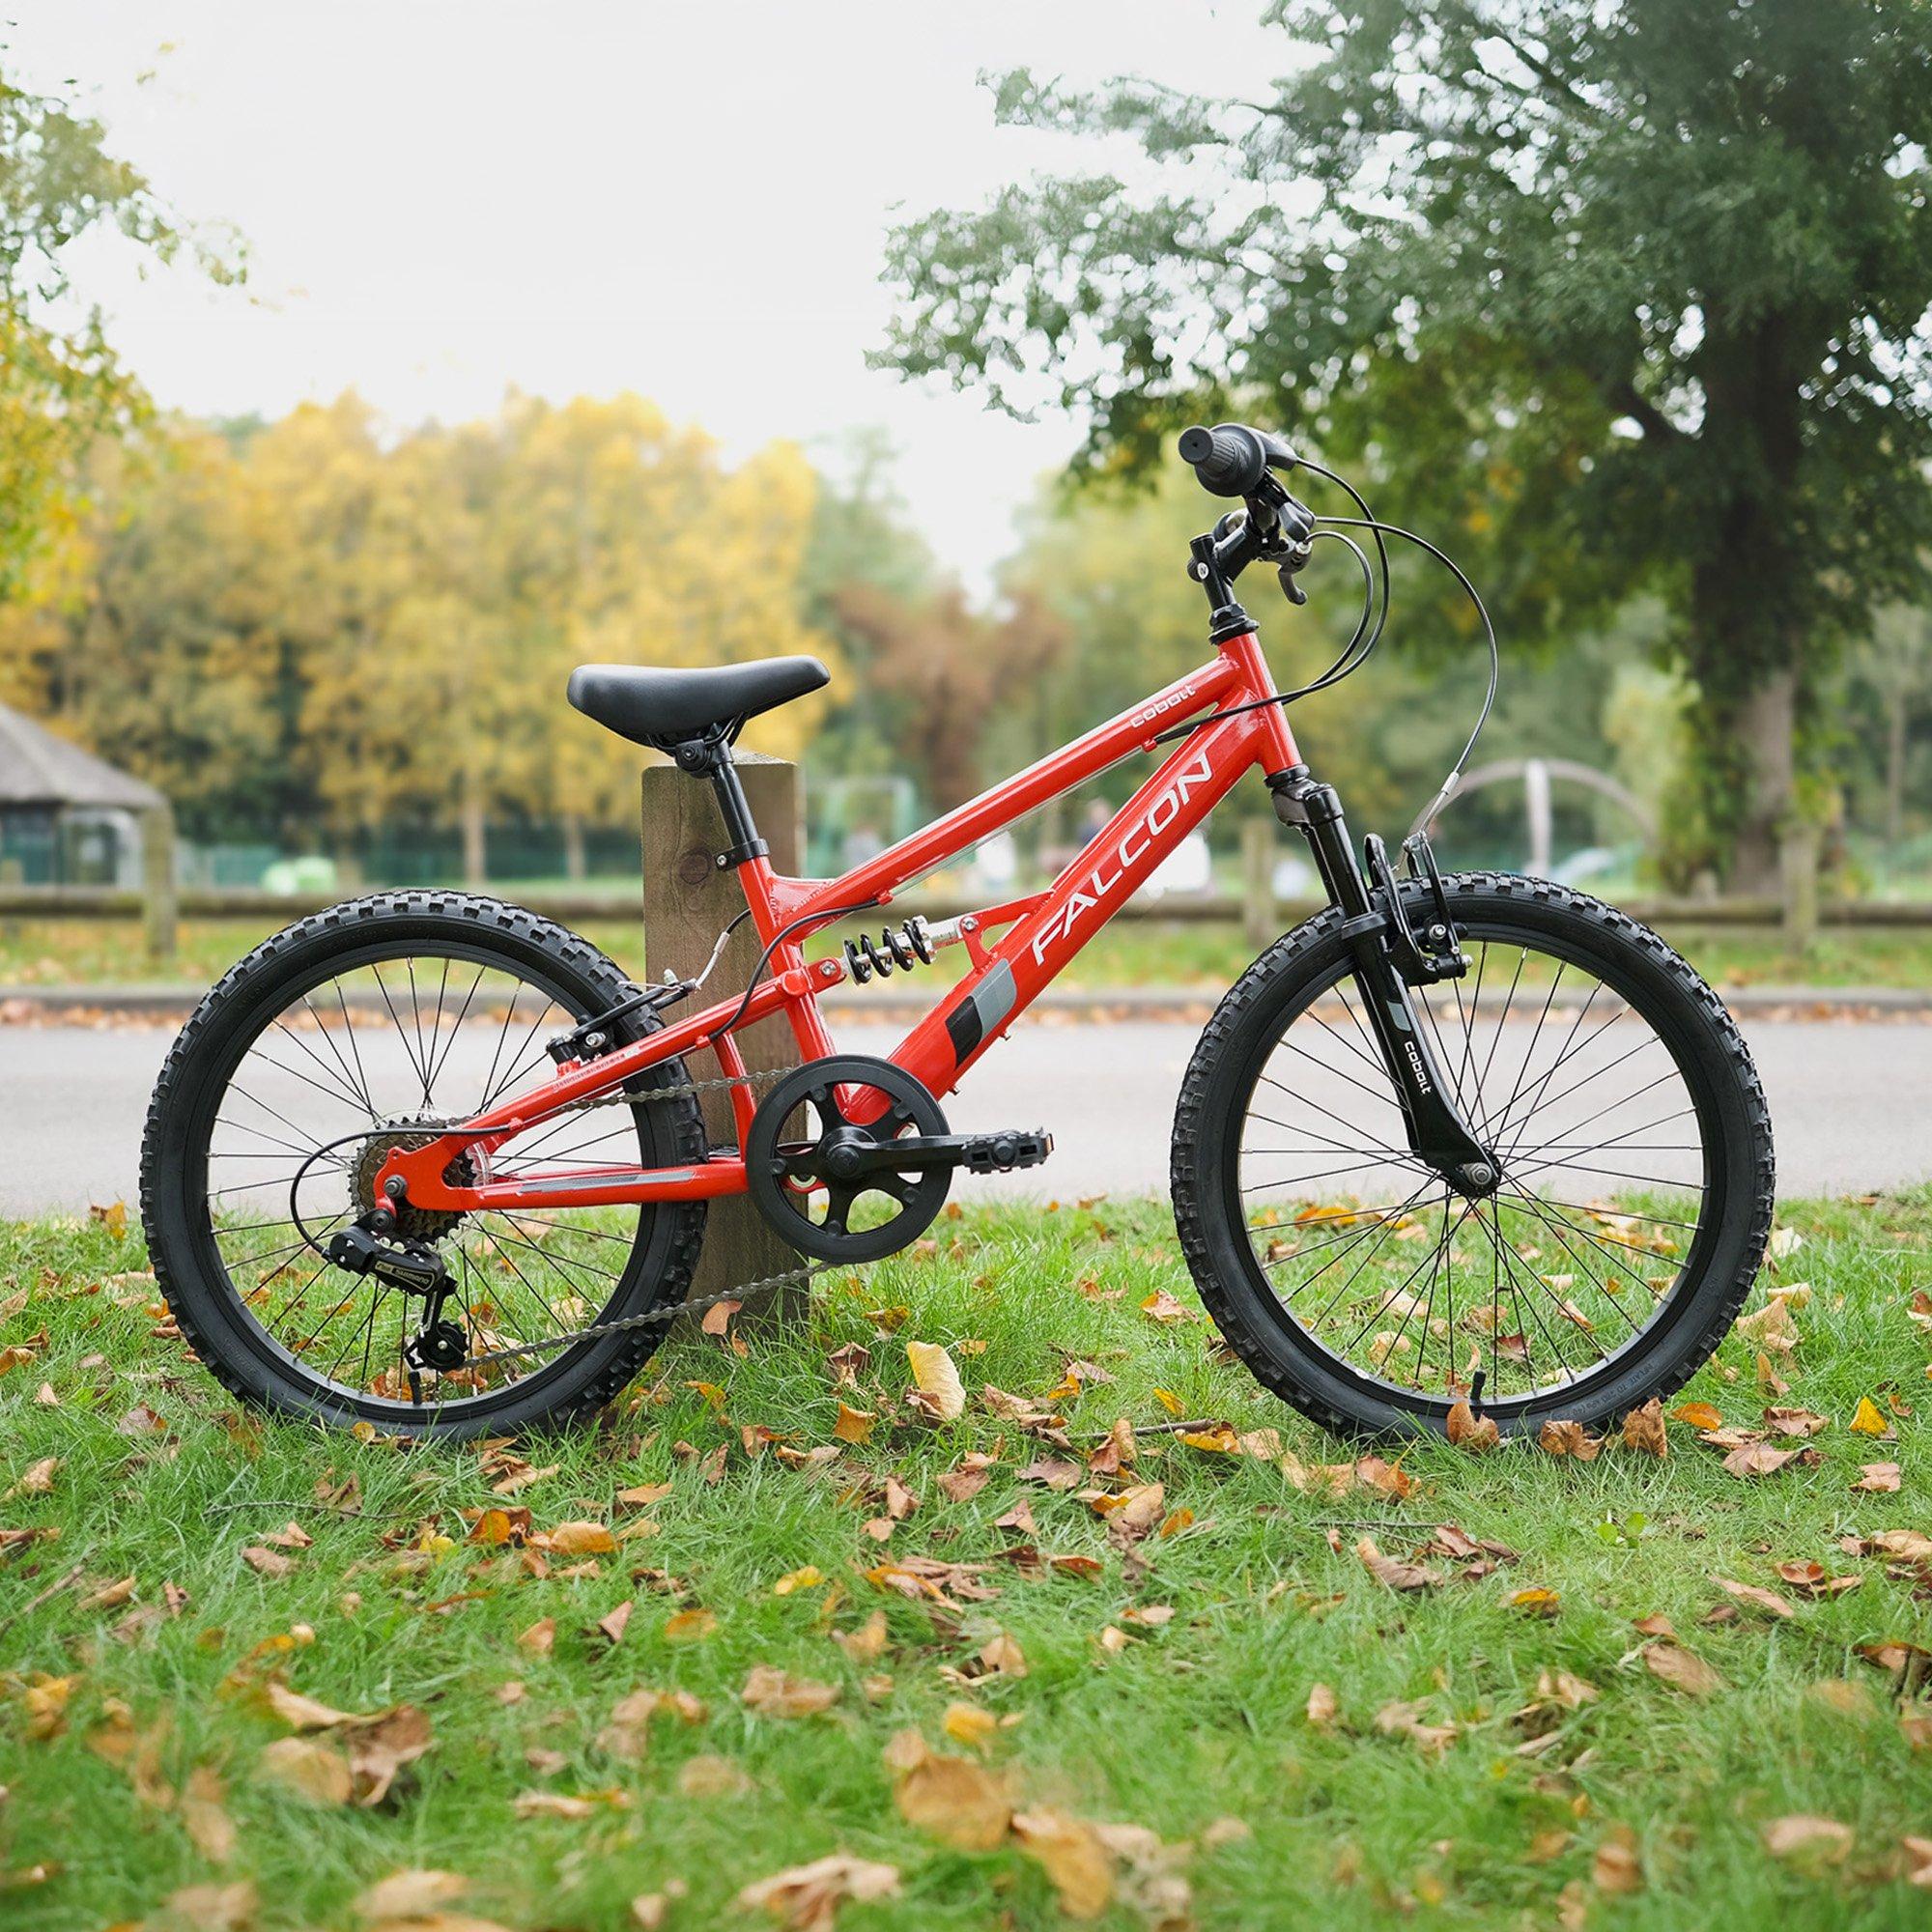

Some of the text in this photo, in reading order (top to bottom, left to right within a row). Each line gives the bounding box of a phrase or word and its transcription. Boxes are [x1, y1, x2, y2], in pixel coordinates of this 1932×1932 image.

[1129, 685, 1196, 728] cobalt
[1032, 752, 1213, 966] FALCON
[1404, 1040, 1432, 1094] cobalt
